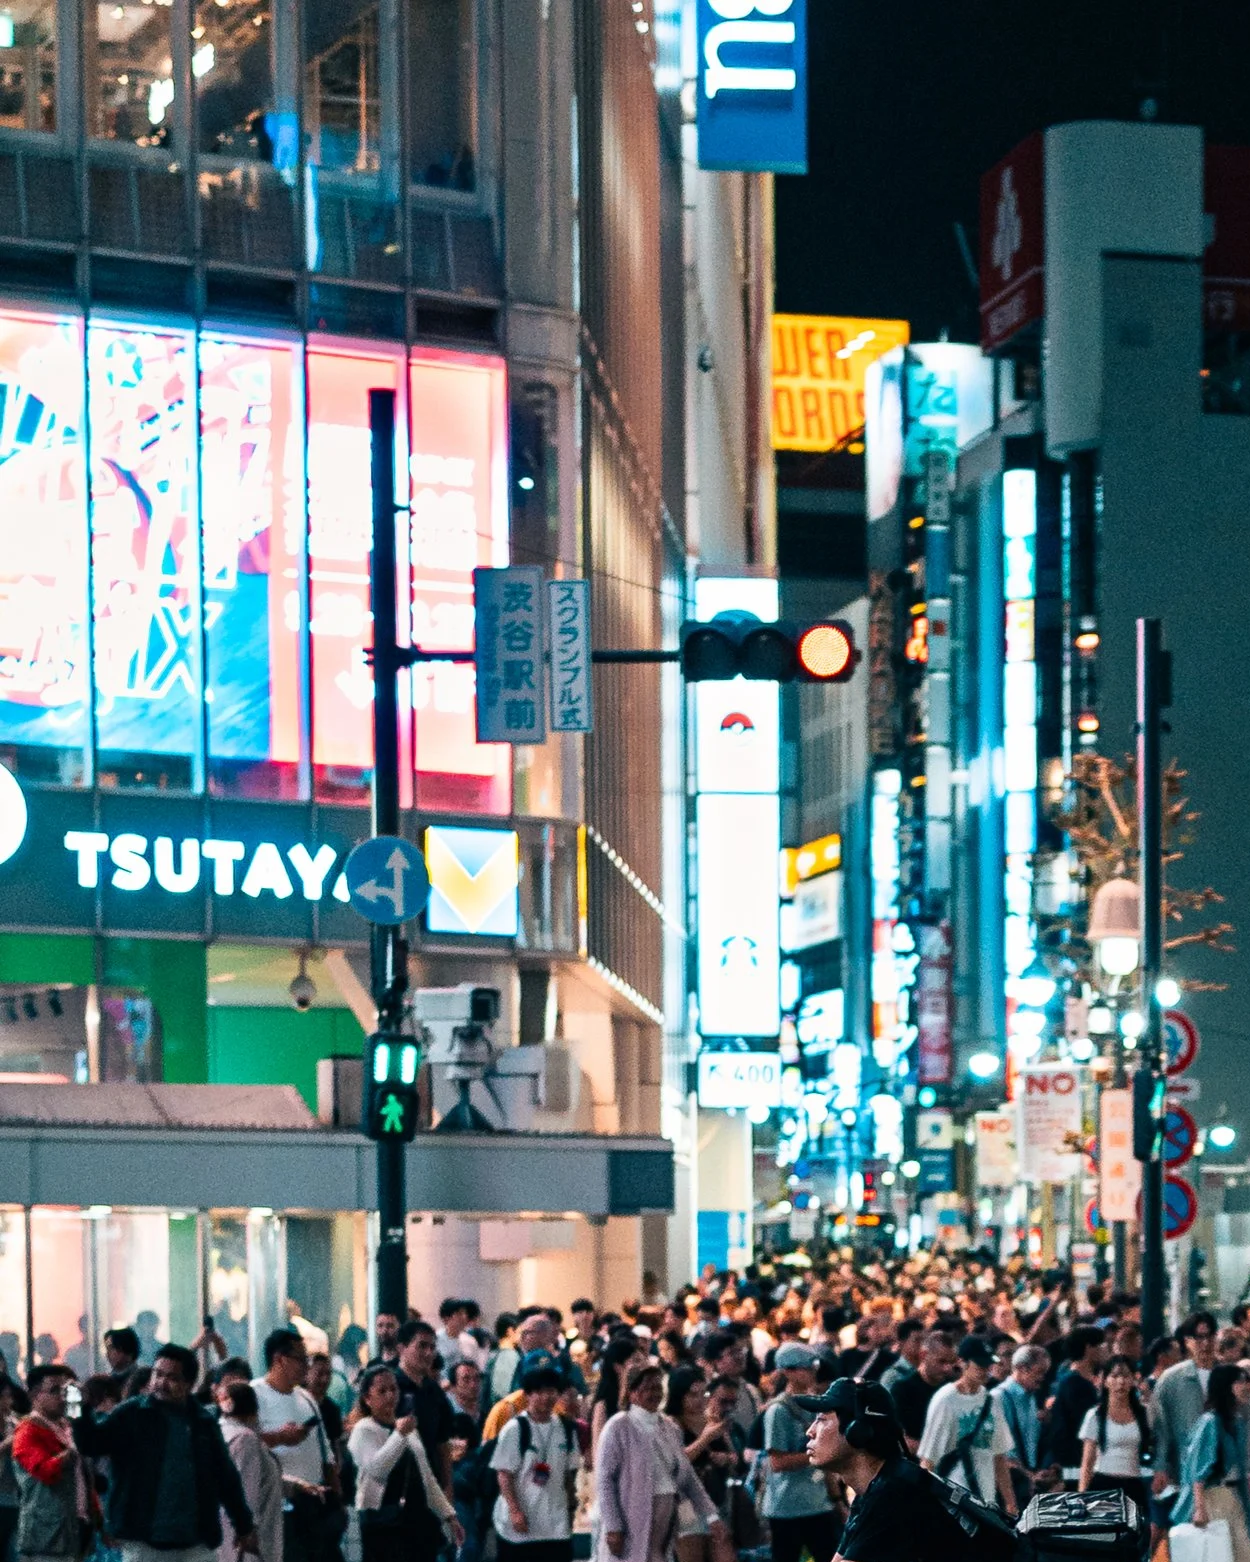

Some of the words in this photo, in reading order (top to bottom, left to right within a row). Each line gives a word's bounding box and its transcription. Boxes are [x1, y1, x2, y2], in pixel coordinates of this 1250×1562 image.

[502, 582, 536, 730] 渋谷駅前
[64, 831, 350, 902] TSUTAY
[1026, 1072, 1076, 1096] NO
[979, 1118, 1012, 1133] NO
